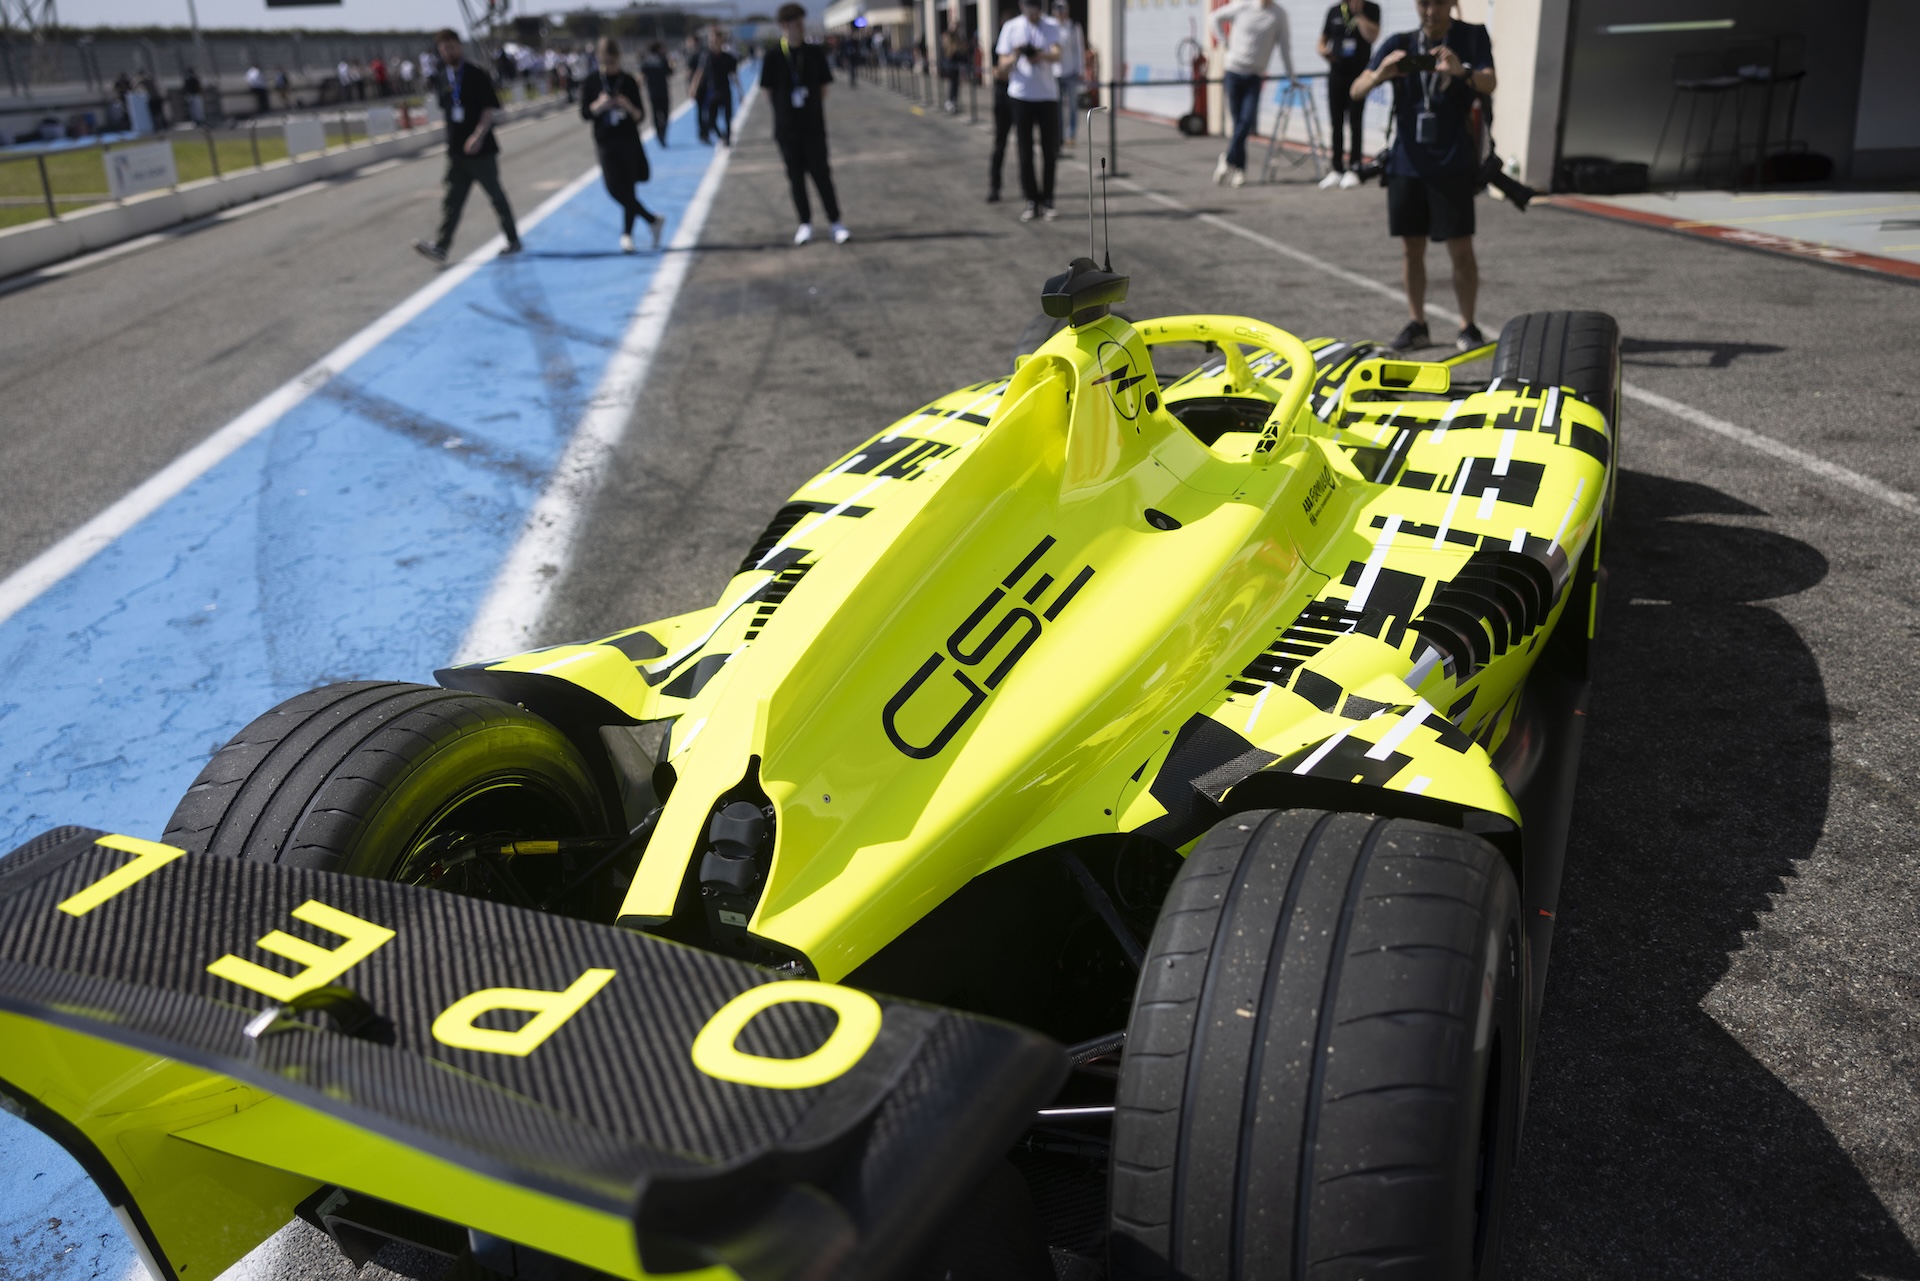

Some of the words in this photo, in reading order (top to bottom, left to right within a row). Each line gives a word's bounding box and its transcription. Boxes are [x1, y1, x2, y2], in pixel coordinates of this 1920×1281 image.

[1234, 326, 1271, 343] GSE
[882, 534, 1096, 760] GSE
[57, 833, 883, 1089] OPEL
